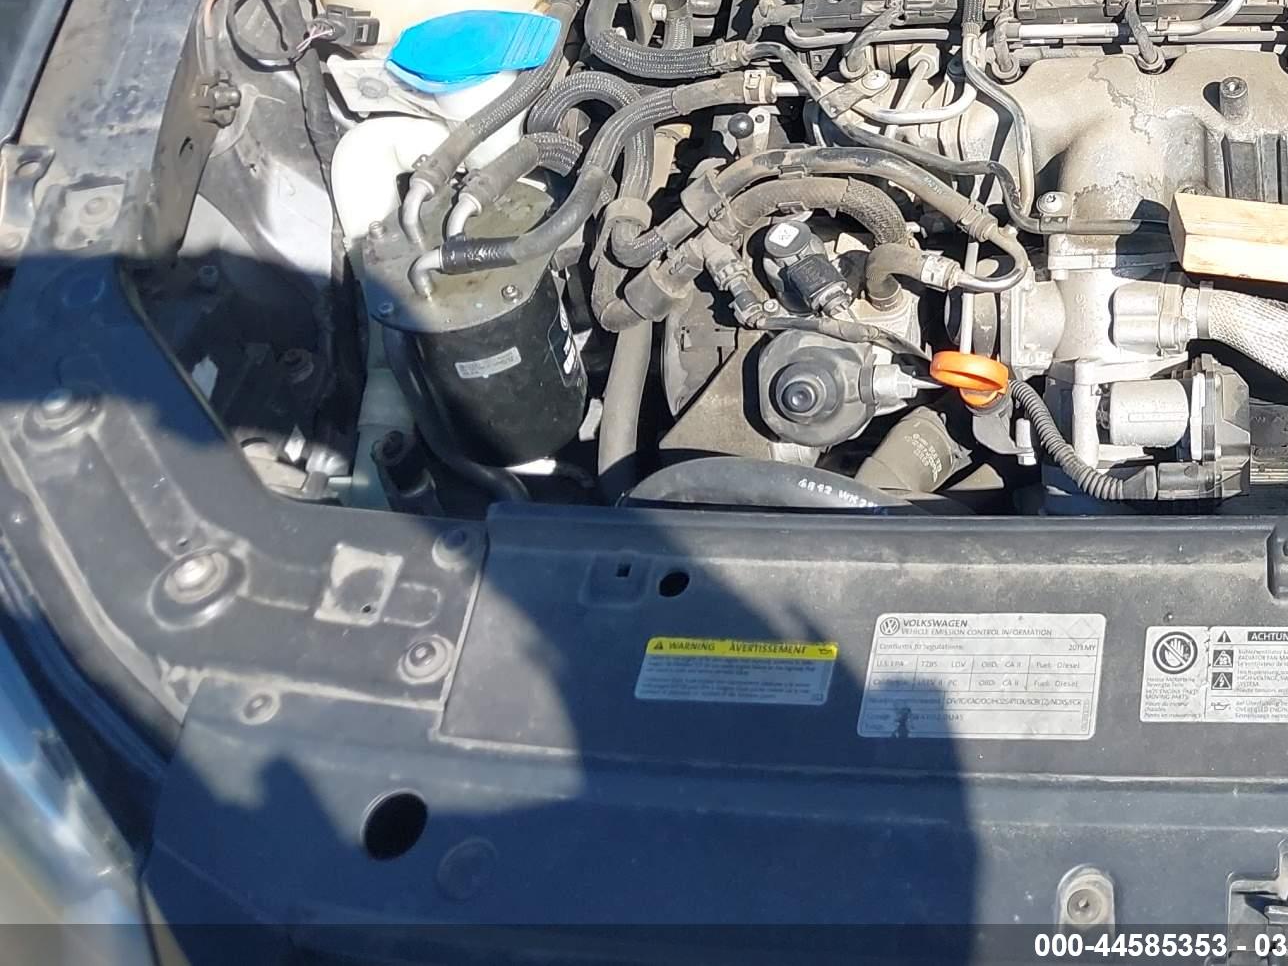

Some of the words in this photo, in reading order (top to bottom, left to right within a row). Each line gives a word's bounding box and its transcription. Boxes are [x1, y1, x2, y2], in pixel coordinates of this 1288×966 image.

[903, 619, 968, 627] VOLKSWAGEN
[668, 642, 715, 651] WARNING
[729, 643, 806, 654] AVERTISSEMENT
